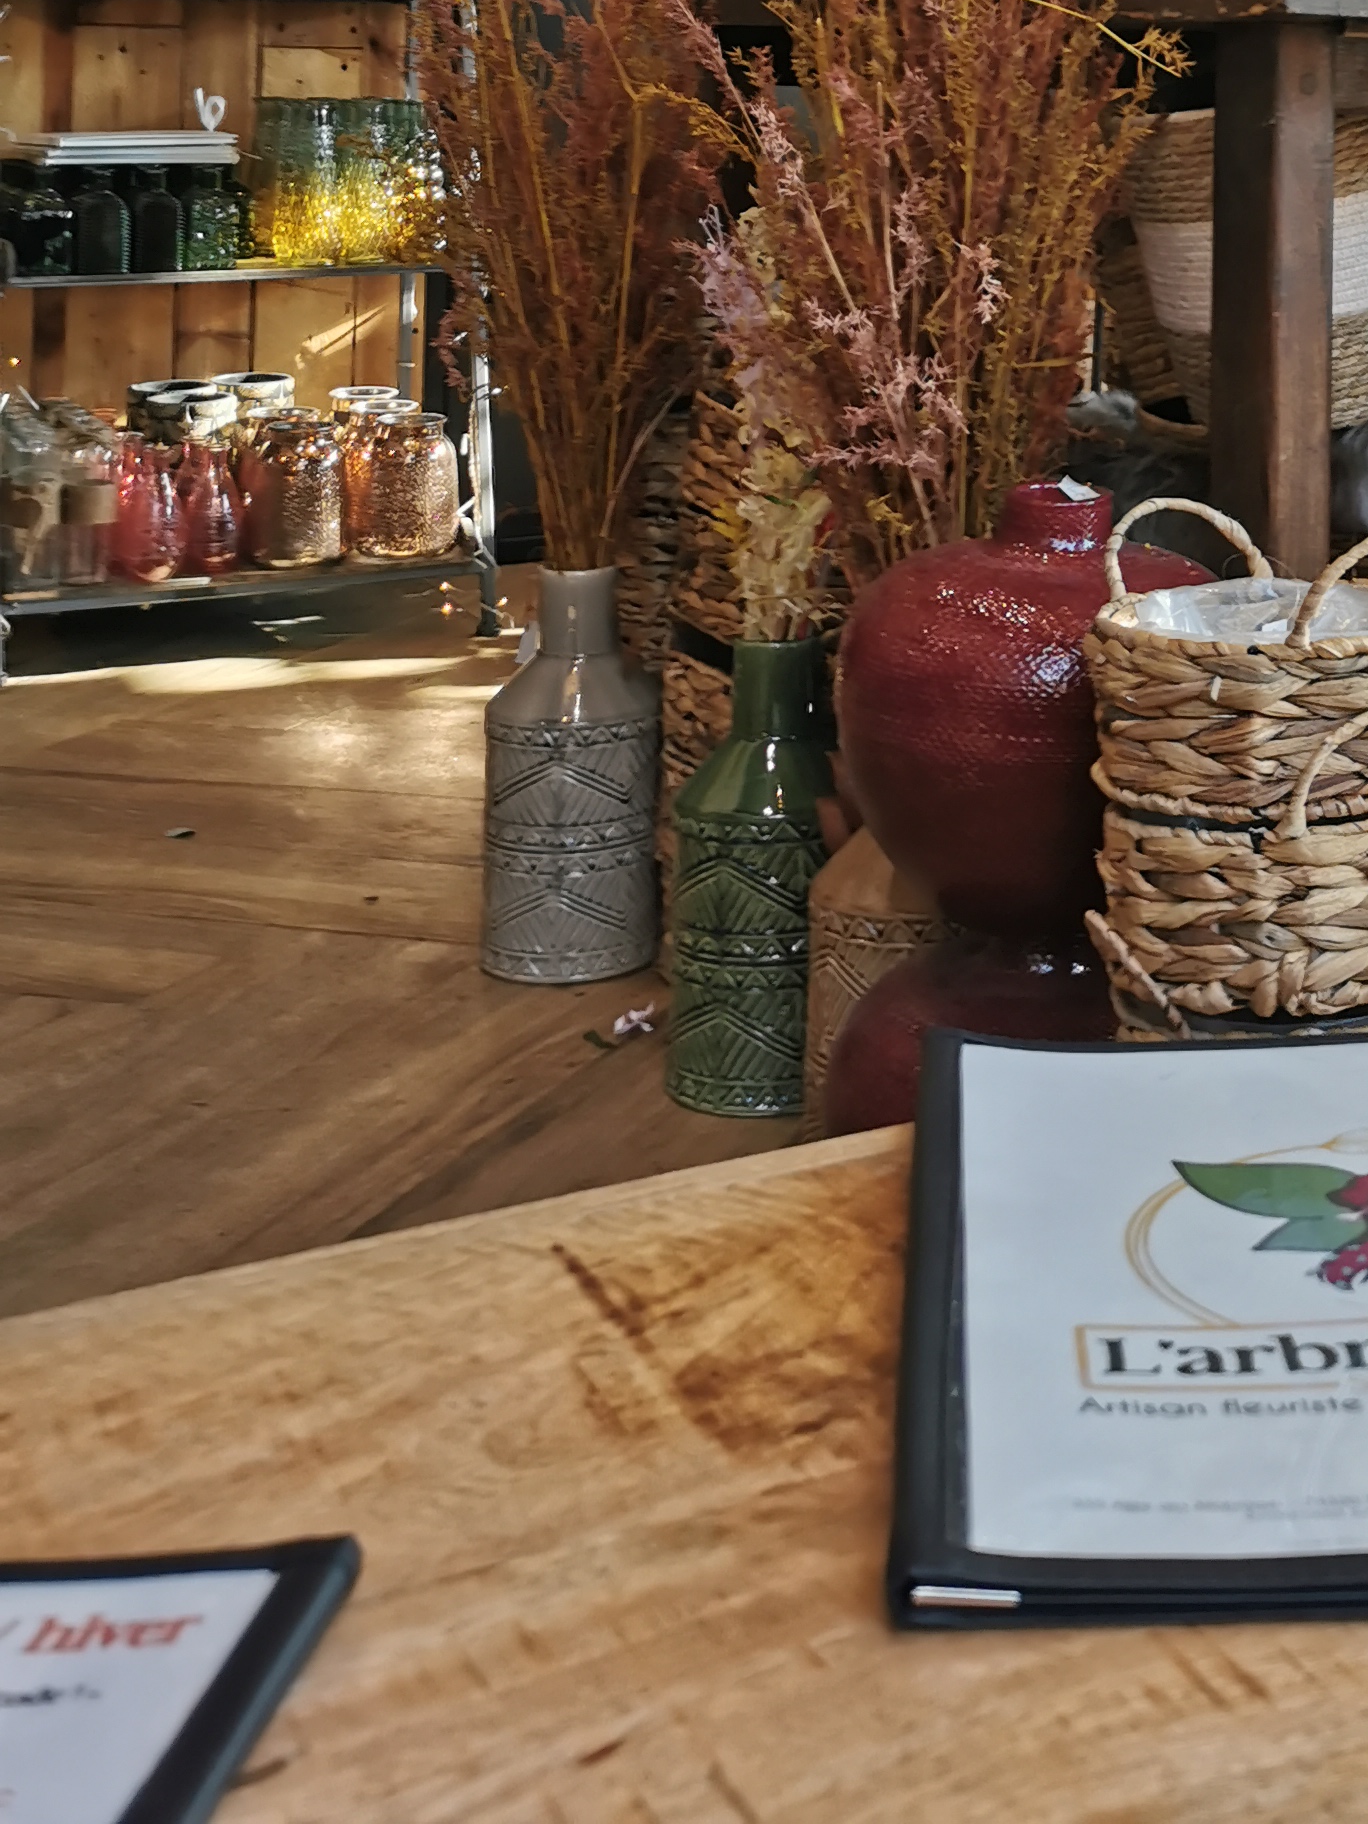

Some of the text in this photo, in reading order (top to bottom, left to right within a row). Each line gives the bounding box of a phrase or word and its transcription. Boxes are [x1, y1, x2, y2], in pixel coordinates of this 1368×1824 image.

[1078, 1396, 1208, 1416] Artisan
[1221, 1395, 1364, 1416] fleuriste
[23, 1610, 204, 1656] hiver
